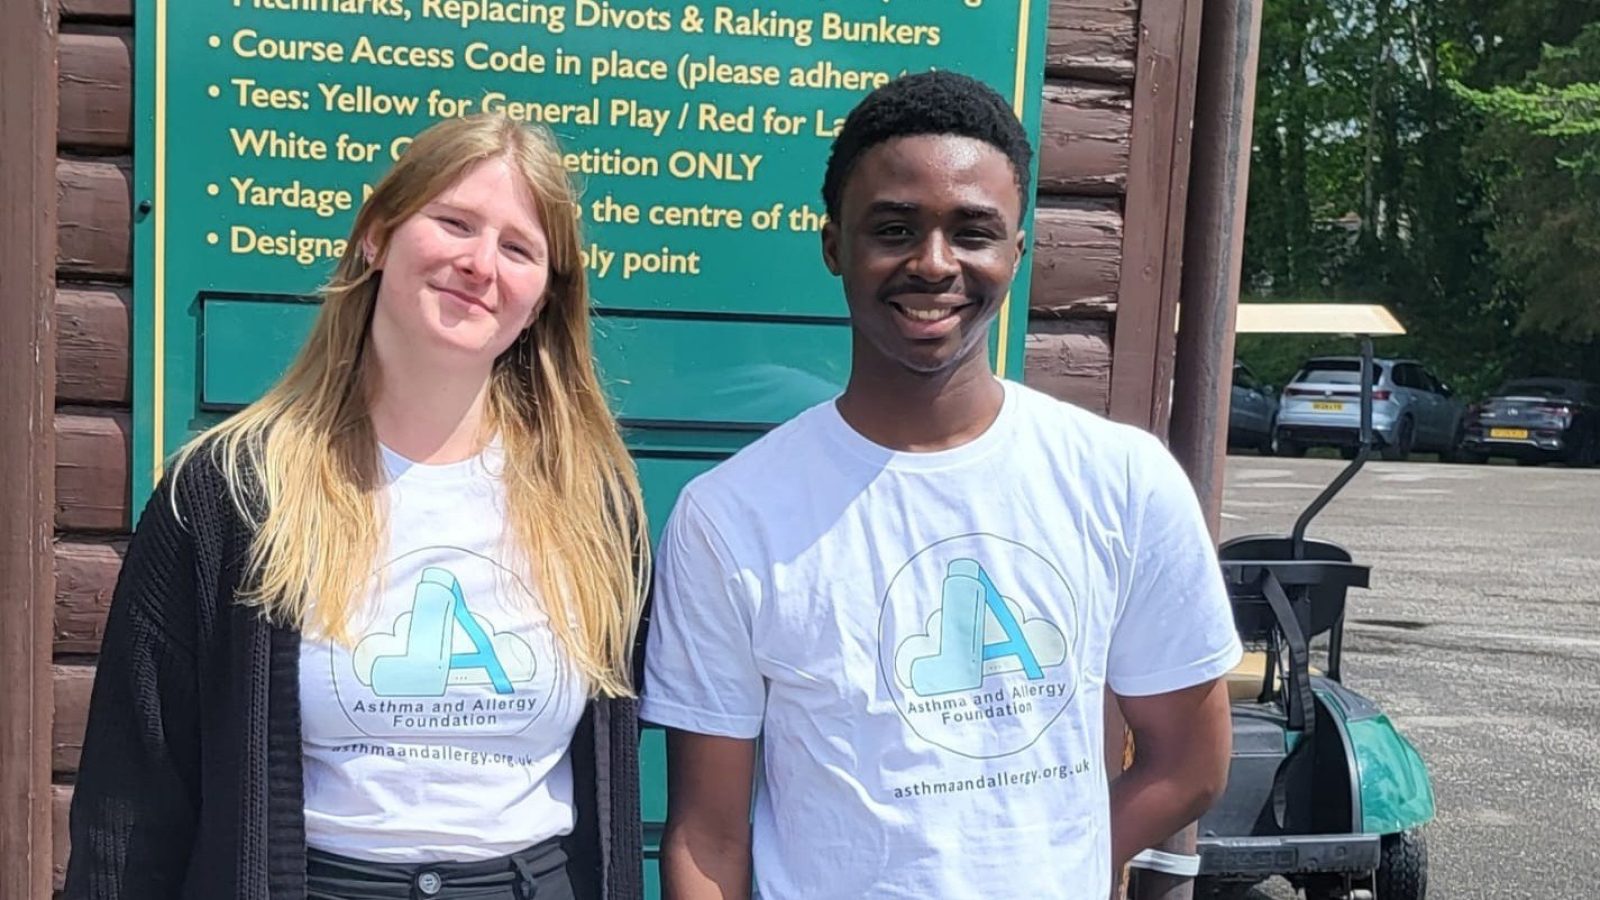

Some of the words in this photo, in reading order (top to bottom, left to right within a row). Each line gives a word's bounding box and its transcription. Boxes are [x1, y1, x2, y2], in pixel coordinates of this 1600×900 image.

[422, 0, 566, 34] Replacing
[575, 0, 672, 31] Divots
[680, 6, 704, 33] &
[714, 7, 813, 47] Raking
[822, 12, 941, 46] Bunkers
[232, 28, 344, 62] Course
[350, 36, 455, 69] Access
[464, 42, 546, 74] Code
[556, 48, 581, 75] in
[591, 50, 668, 84] place
[677, 53, 780, 89] (please
[788, 61, 890, 90] adhere
[231, 79, 310, 110] Tees:
[318, 84, 419, 117] Yellow
[427, 89, 473, 118] for
[481, 92, 600, 125] General
[610, 99, 671, 137] Play
[678, 103, 689, 130] /
[698, 104, 755, 133] Red
[763, 107, 807, 135] for
[230, 128, 328, 161] White
[335, 134, 382, 162] for
[668, 151, 763, 181] ONLY
[230, 178, 352, 218] Yardage
[591, 195, 640, 224] the
[648, 202, 743, 229] centre
[751, 203, 784, 230] of
[231, 225, 349, 265] Designa
[623, 246, 701, 279] point
[353, 699, 424, 714] Asthma
[432, 699, 464, 713] and
[472, 696, 537, 712] Allergy
[392, 713, 497, 728] Foundation
[908, 694, 967, 715] Asthma
[973, 688, 1004, 706] and
[1011, 683, 1067, 699] Allergy
[941, 702, 1033, 725] Foundation
[894, 758, 1091, 799] asthmaandallergy.org.uk
